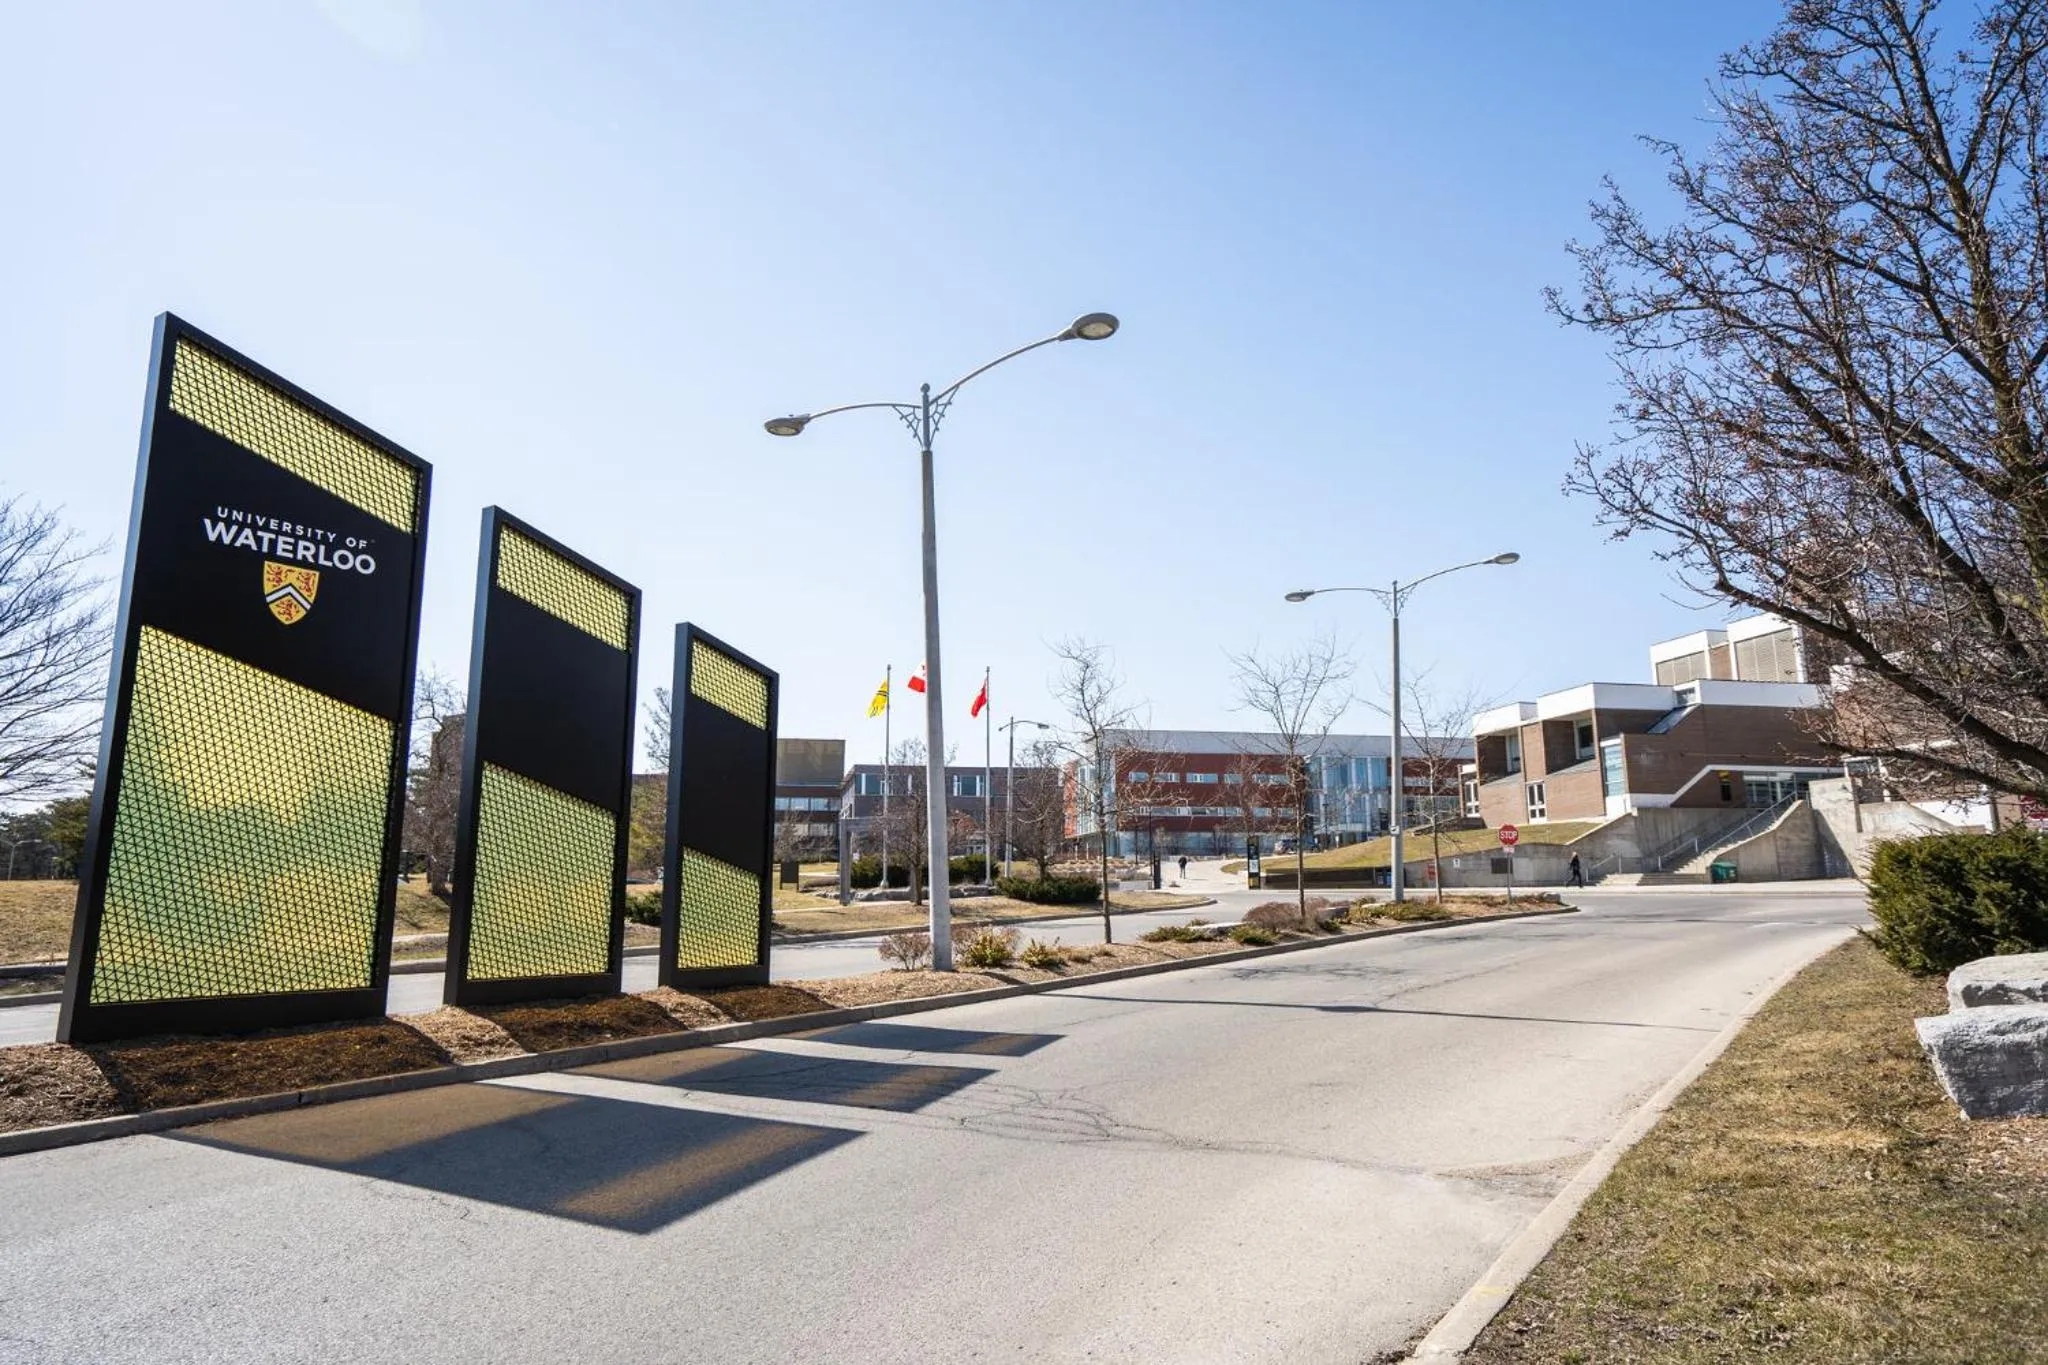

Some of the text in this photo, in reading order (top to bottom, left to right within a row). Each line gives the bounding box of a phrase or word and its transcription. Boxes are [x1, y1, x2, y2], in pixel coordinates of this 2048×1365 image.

[203, 518, 376, 575] WATERLOO
[217, 506, 367, 549] UNIVERSITY OF
[1500, 831, 1517, 840] STOP
